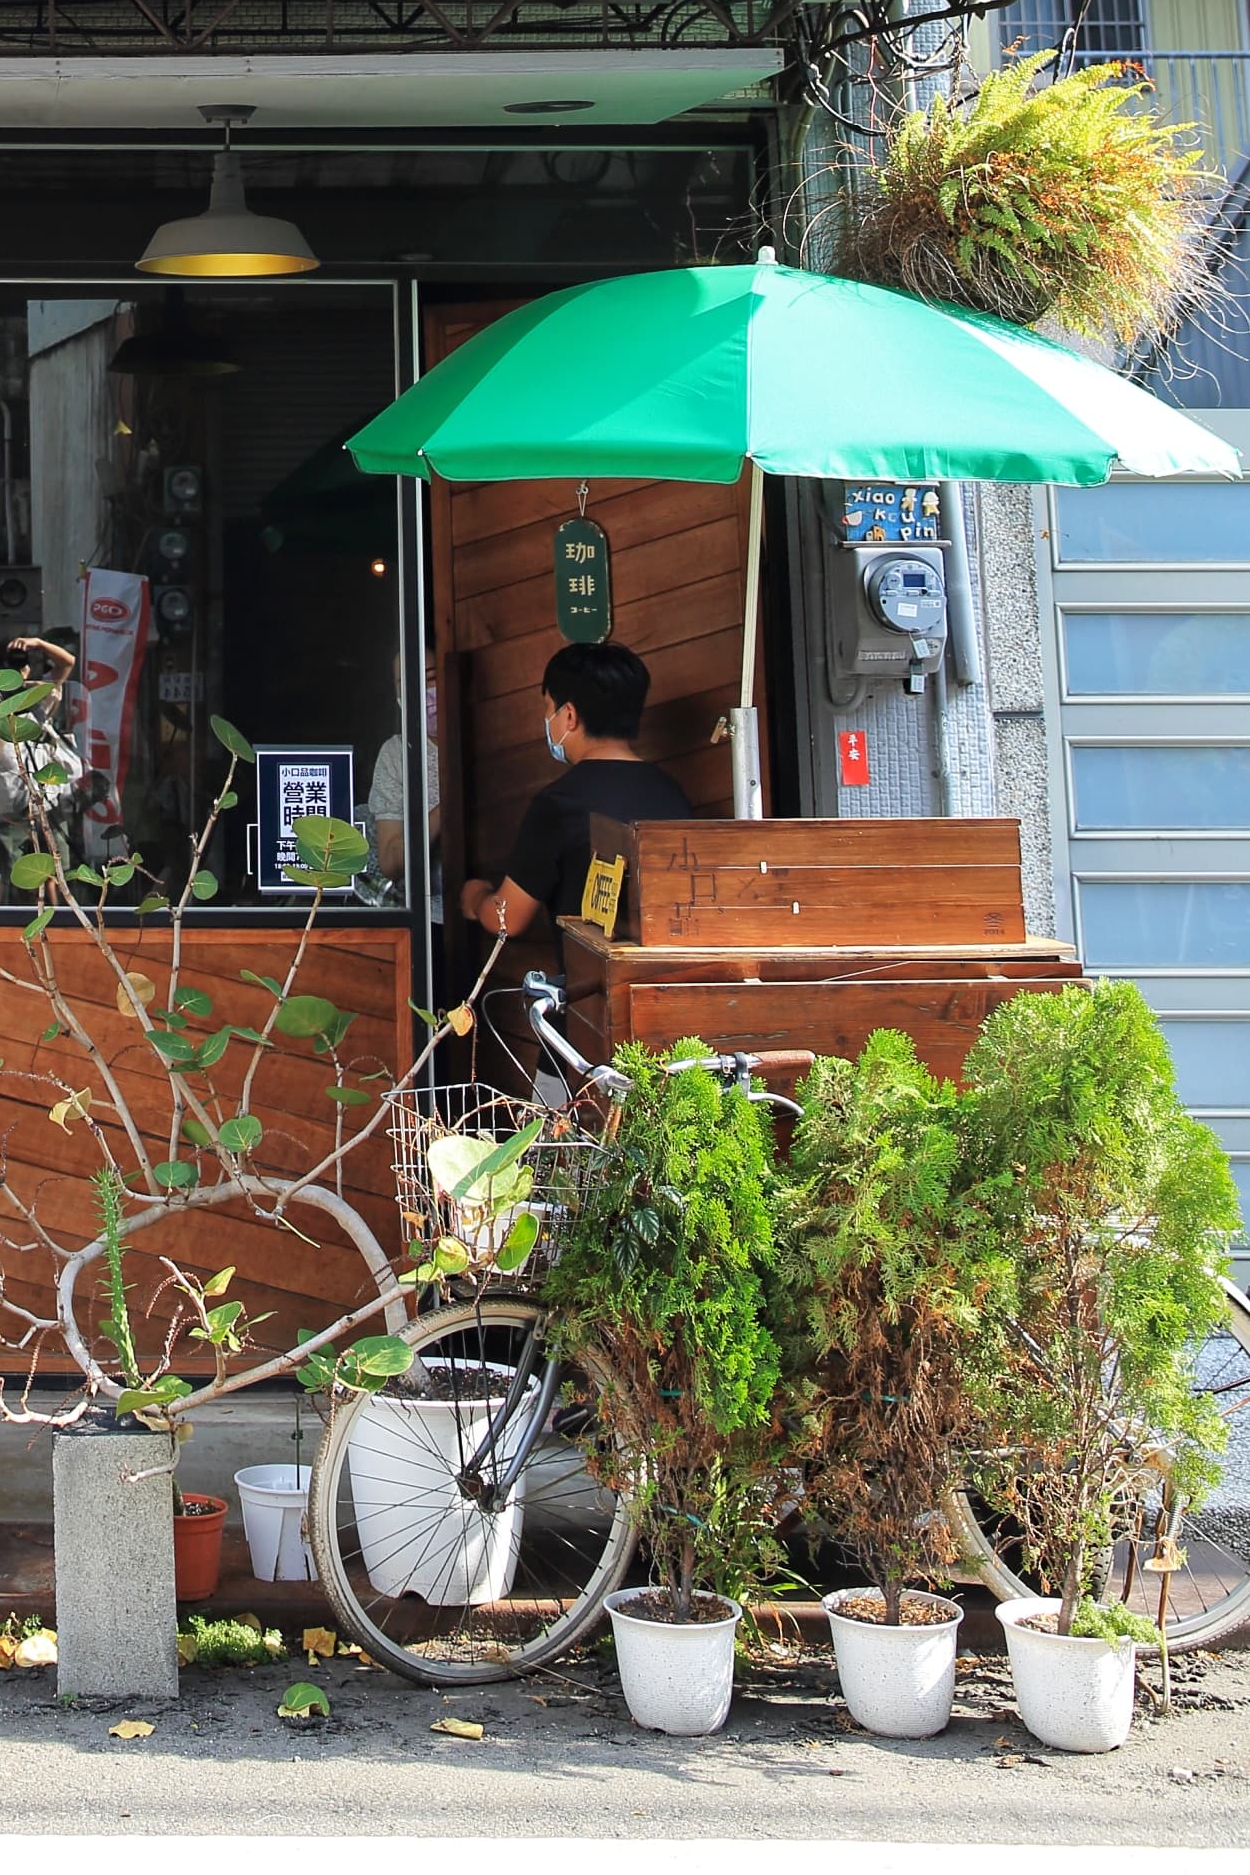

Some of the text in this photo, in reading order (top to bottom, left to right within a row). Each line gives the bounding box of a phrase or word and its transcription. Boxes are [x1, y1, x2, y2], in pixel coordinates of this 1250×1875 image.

[852, 486, 895, 504] xiao
[900, 522, 934, 541] pin
[566, 542, 595, 596] 珈琲
[281, 767, 327, 777] 小口品咖啡
[283, 781, 327, 804] 營業
